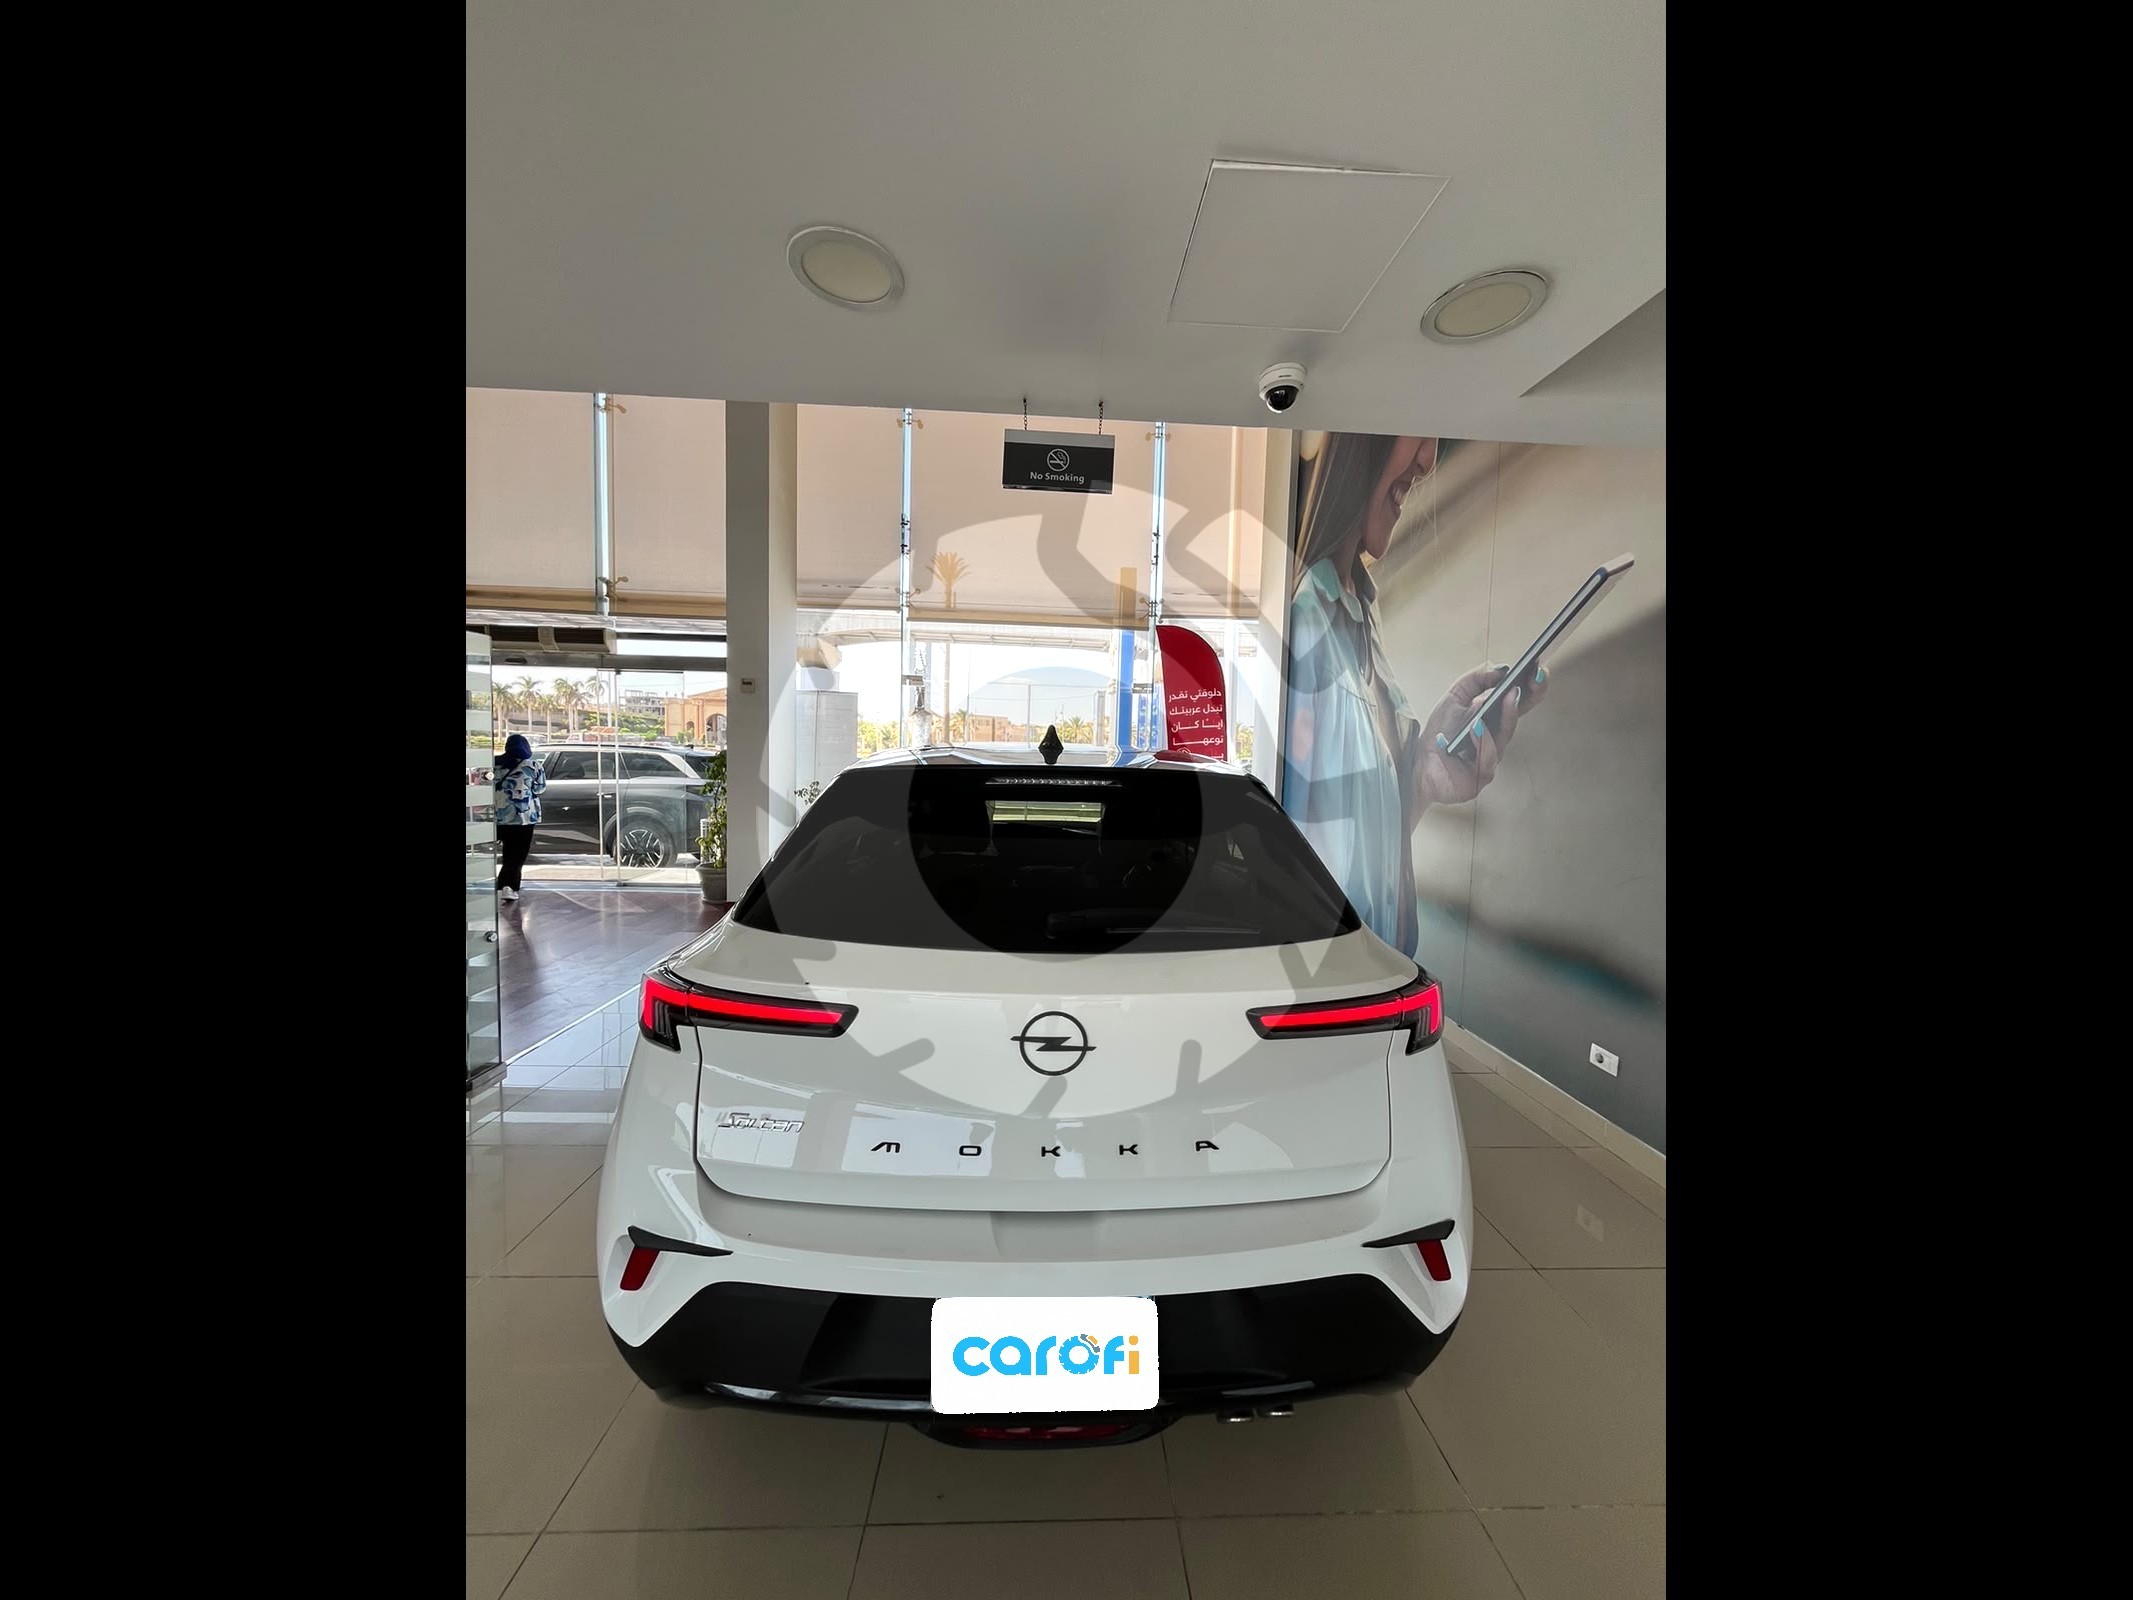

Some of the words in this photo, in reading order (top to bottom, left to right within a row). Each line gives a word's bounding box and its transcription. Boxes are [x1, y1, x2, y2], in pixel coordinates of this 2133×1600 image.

[1030, 471, 1043, 480] No
[1045, 472, 1085, 484] Smoking
[871, 1140, 1220, 1158] MOKKA
